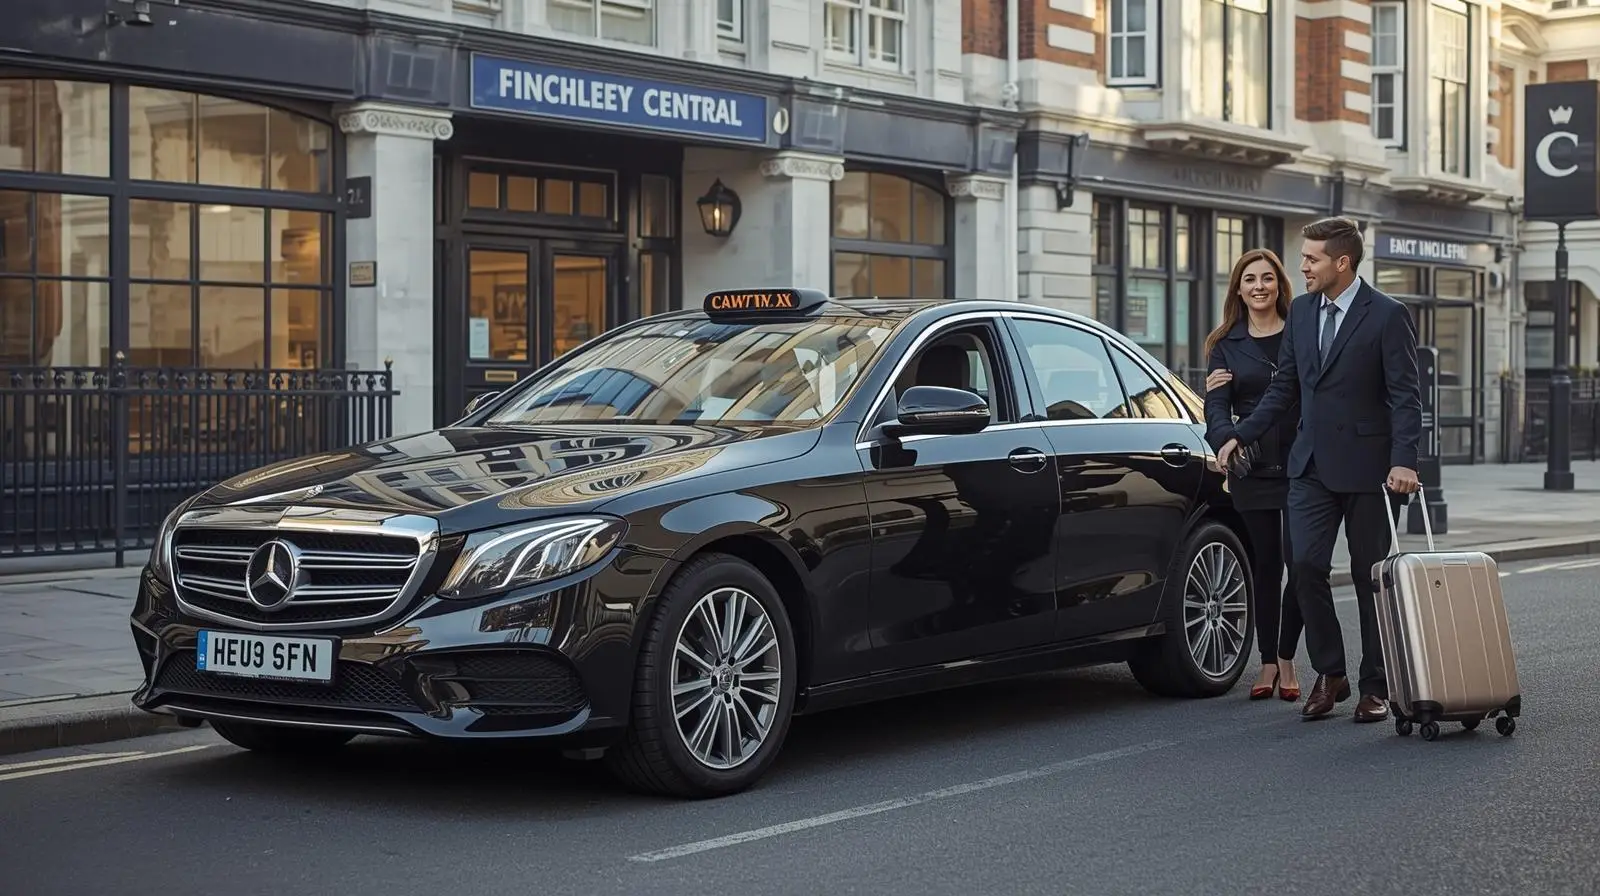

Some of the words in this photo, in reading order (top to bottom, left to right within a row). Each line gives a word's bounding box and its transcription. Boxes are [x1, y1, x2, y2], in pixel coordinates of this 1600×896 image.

[499, 68, 634, 113] FINCHLEEY
[642, 88, 742, 126] CENTRAL
[1535, 131, 1579, 177] C
[272, 642, 317, 672] SFN
